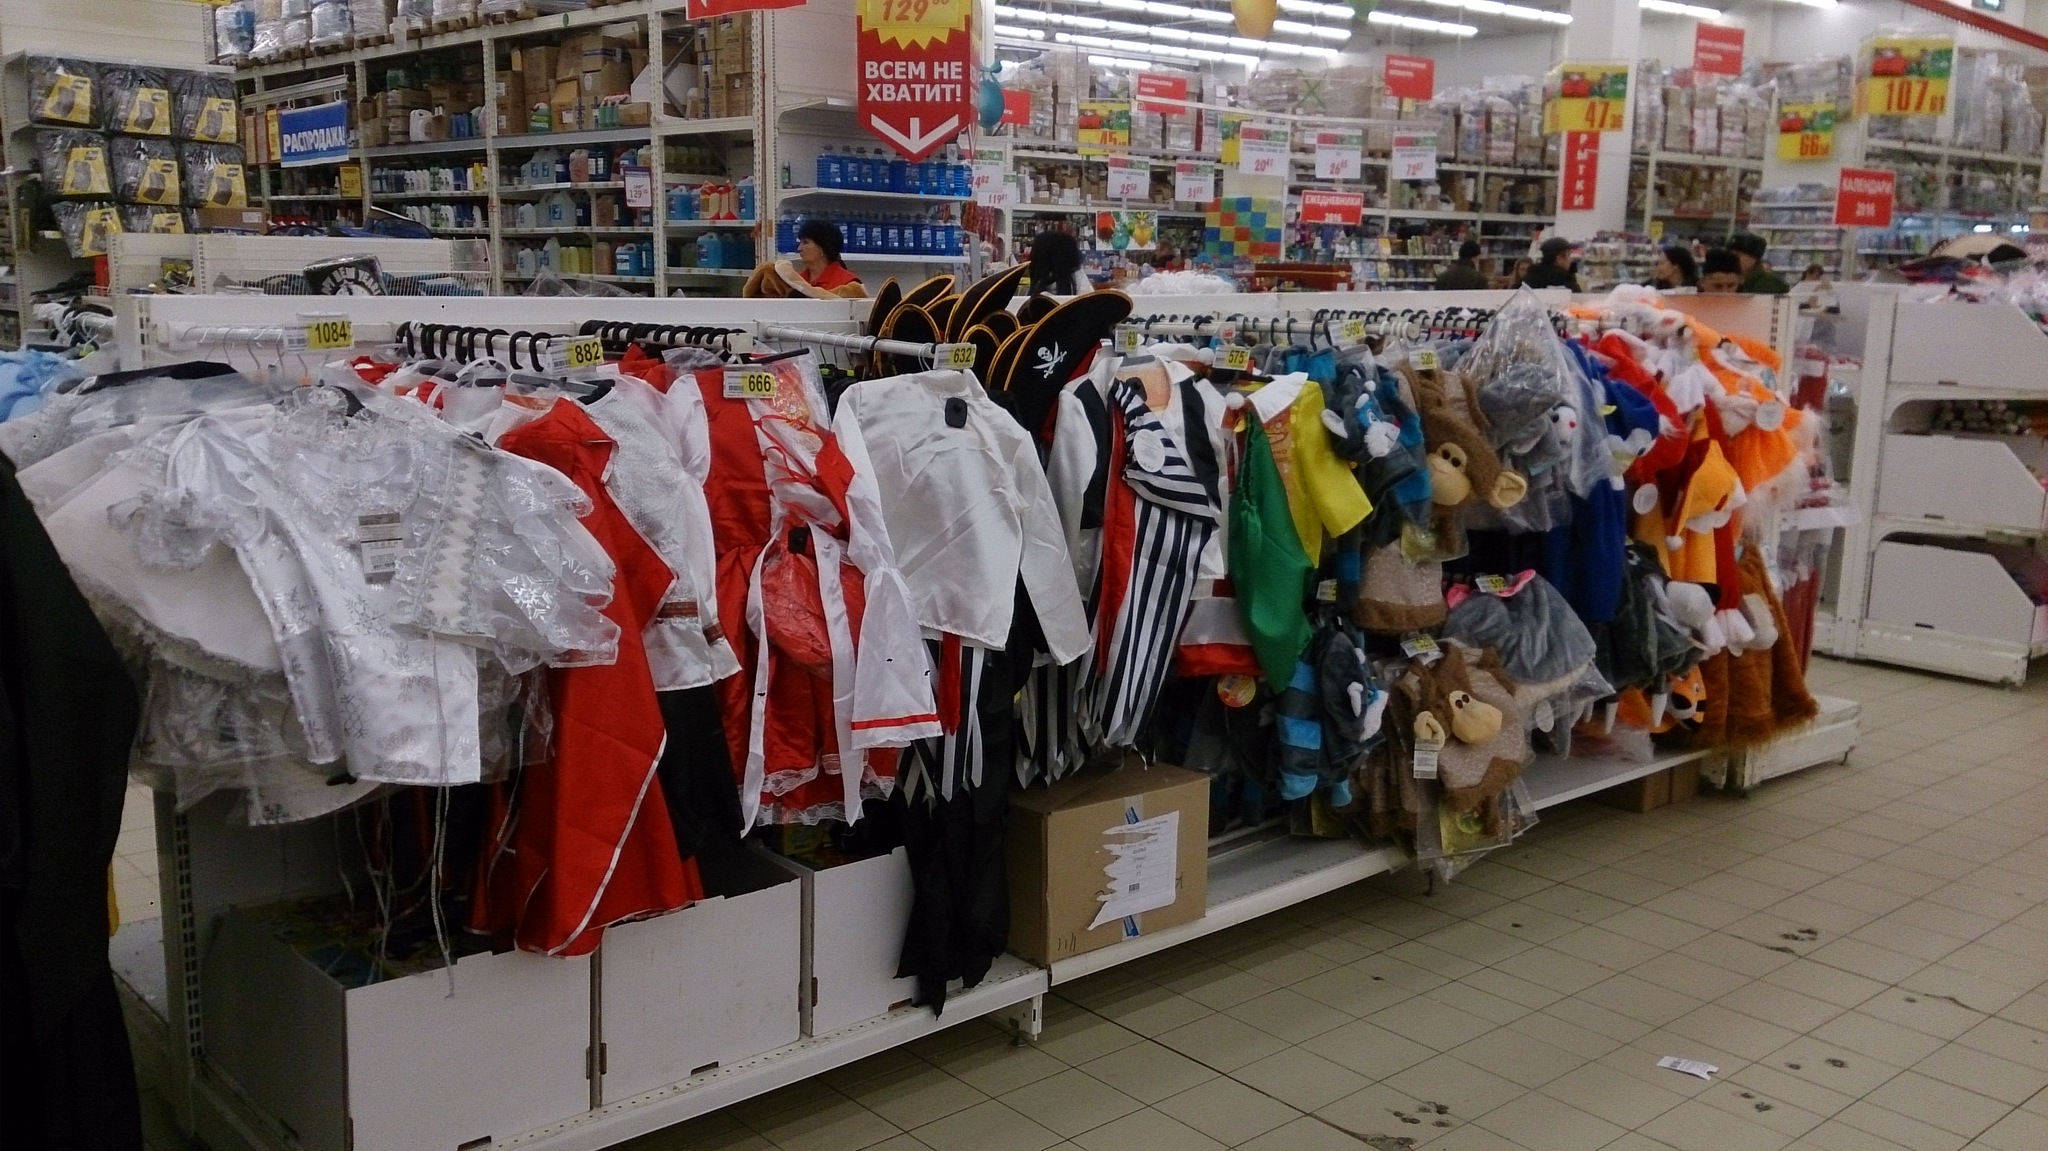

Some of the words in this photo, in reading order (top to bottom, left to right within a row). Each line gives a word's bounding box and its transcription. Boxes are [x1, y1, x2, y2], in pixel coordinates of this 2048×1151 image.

[882, 0, 929, 22] 129
[865, 61, 926, 79] ВСЕМ
[933, 61, 962, 79] НЕ
[866, 83, 962, 102] ХВАТИТ!
[1887, 80, 1928, 112] 107
[1585, 101, 1610, 129] 47
[282, 125, 346, 154] РАСПРОДАЖА!
[1304, 194, 1361, 207] ЕЖЕДНЕВНИКИ
[314, 321, 348, 344] 1084
[1127, 331, 1137, 347] 63
[574, 341, 601, 364] 882
[953, 347, 972, 364] 632
[1228, 349, 1246, 365] 575
[748, 374, 772, 392] 666
